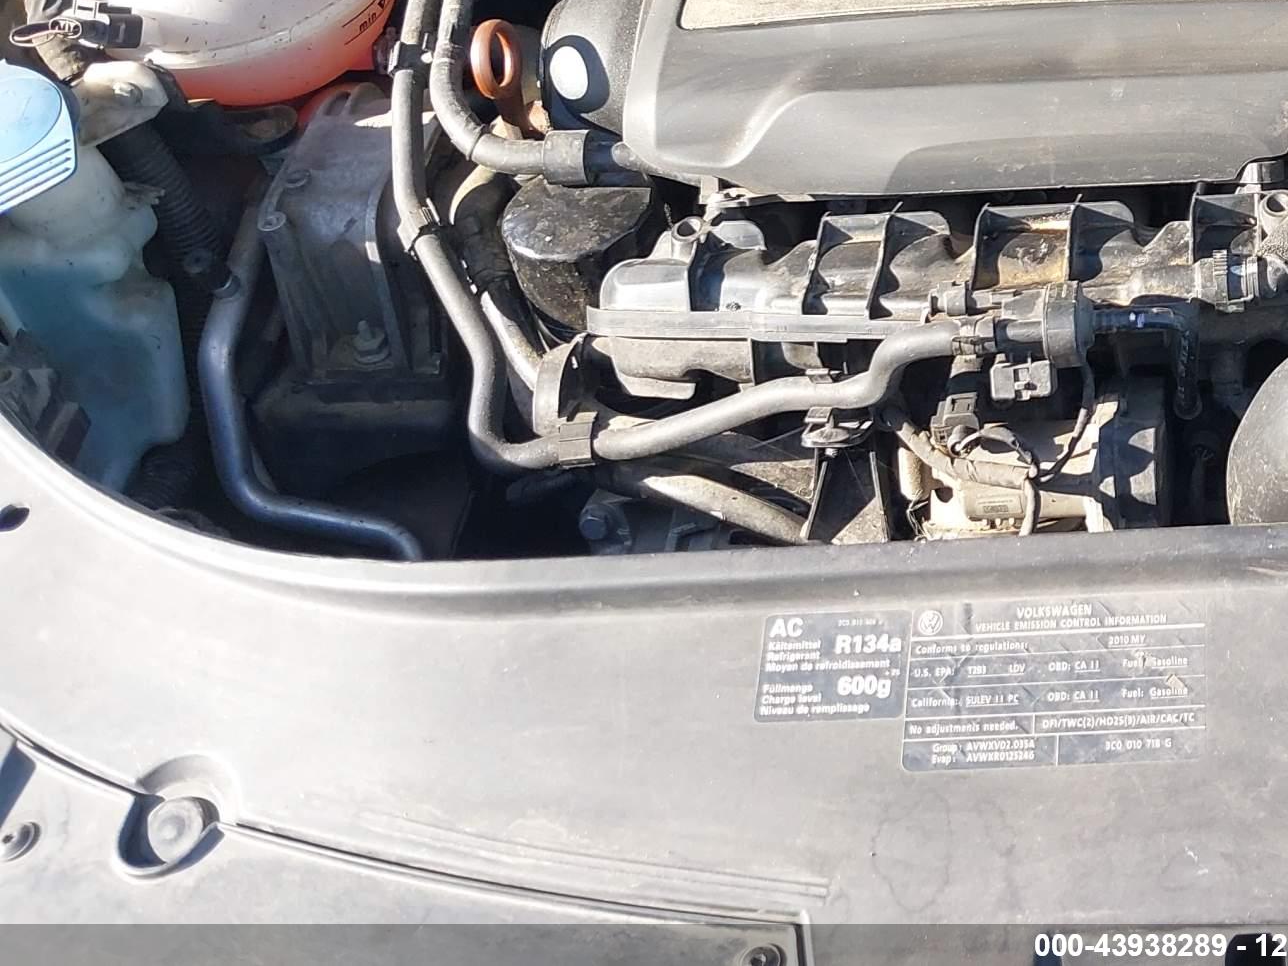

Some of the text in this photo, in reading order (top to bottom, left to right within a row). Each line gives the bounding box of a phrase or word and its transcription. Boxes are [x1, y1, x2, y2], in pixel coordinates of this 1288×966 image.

[359, 12, 377, 34] min
[1016, 604, 1092, 619] VOLKSWAGEN
[769, 617, 804, 638] AC
[976, 614, 1167, 633] VEHICLE EMISSION CONTROL INFORMATION
[834, 633, 902, 654] R134a
[1108, 634, 1146, 646] 2010 MY
[915, 644, 957, 654] Conforms
[961, 644, 971, 652] to
[766, 651, 820, 663] Refrigerant
[765, 659, 890, 673] Moyen de refroidissement
[1009, 663, 1026, 673] LDV
[1048, 662, 1071, 671] OBD:
[1074, 660, 1087, 670] CA
[837, 675, 892, 698] 600g
[761, 693, 822, 706] Charge level
[966, 695, 992, 705] SULEV
[1008, 693, 1019, 703] PC
[1047, 692, 1070, 702] OBD:
[1074, 690, 1087, 700] CA
[1121, 688, 1144, 698] Fuel:
[760, 702, 870, 715] Niveau de remplissage
[909, 720, 1019, 735] No adjustments needed.
[1126, 739, 1143, 749] 010
[1165, 737, 1172, 748] G
[932, 754, 956, 766] Evap:
